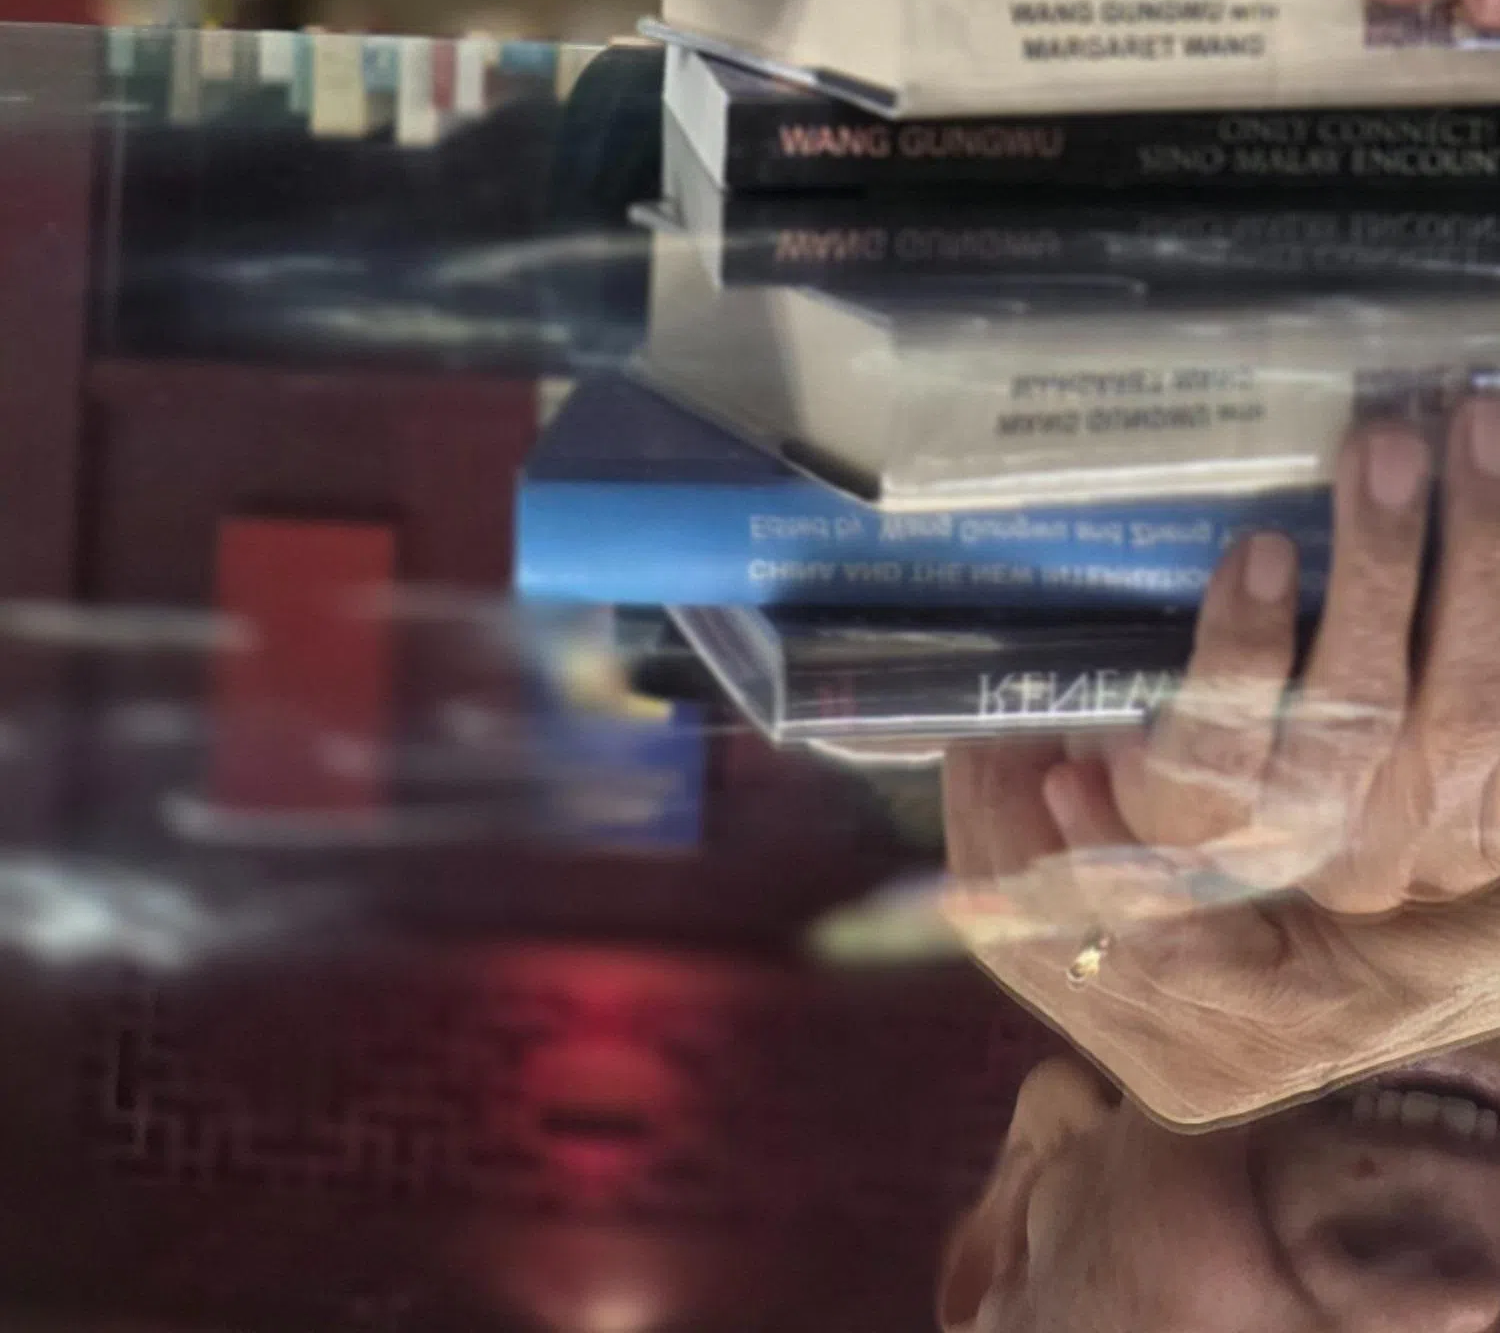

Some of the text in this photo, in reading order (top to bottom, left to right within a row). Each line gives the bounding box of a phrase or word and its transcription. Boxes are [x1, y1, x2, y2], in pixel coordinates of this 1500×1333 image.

[1022, 34, 1266, 60] MARGARET WANG
[779, 124, 1065, 158] WANG GUNGWU
